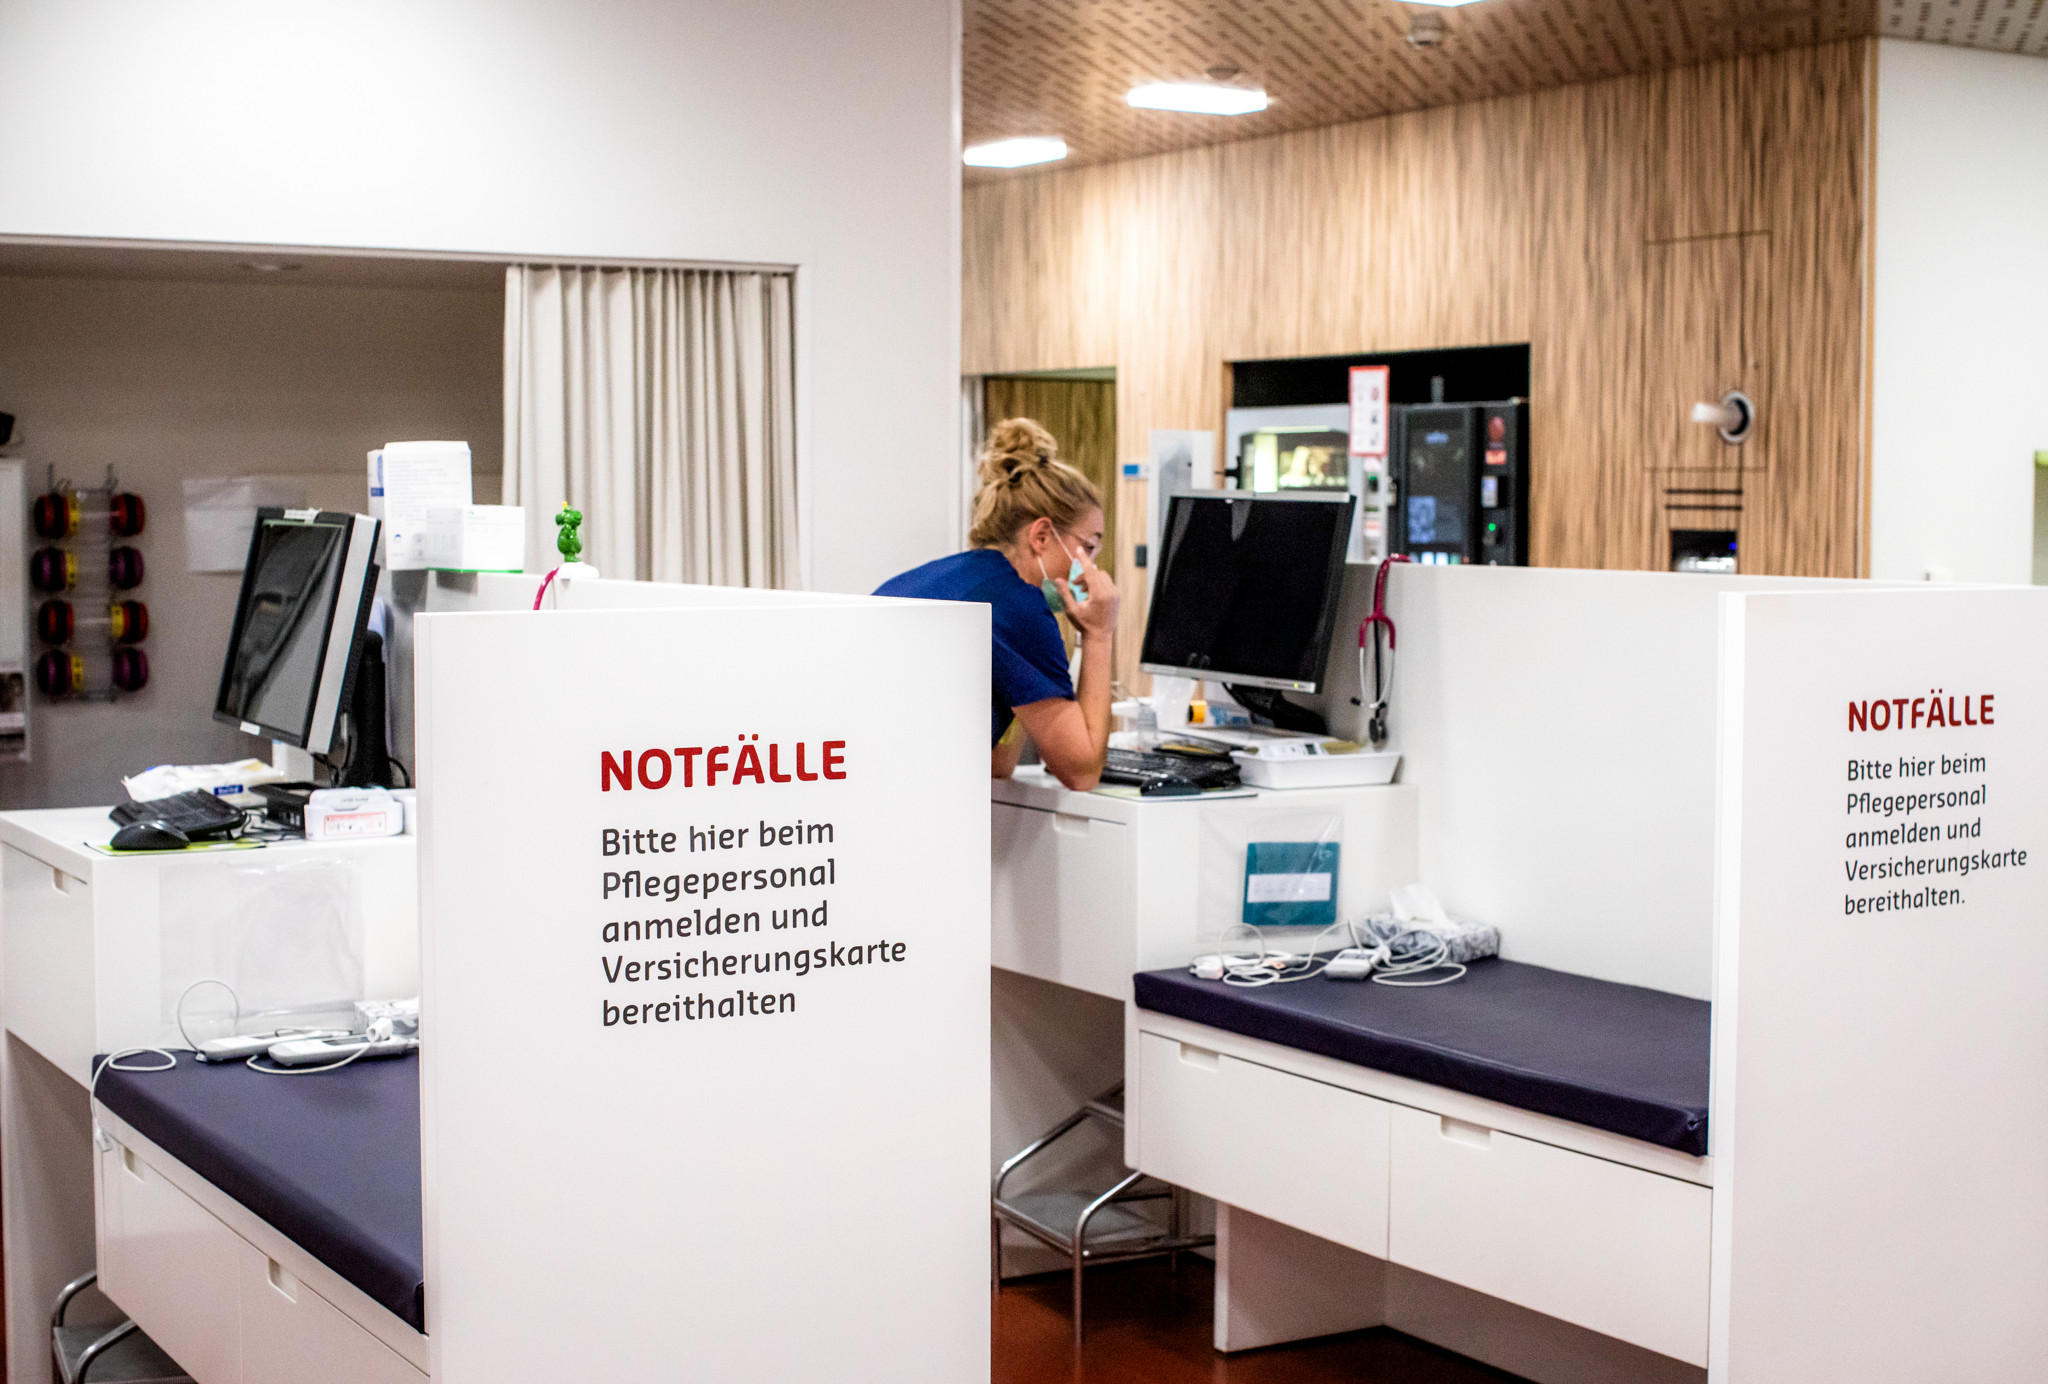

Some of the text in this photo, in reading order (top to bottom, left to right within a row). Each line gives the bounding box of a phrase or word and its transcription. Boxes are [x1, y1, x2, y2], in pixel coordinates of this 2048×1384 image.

[1848, 688, 1995, 732] NOTFÄLLE
[601, 733, 847, 792] NOTFÄLLE
[1847, 752, 1986, 781] Bitte hier beim
[1847, 784, 1987, 817] Pflegepersonal
[602, 819, 834, 856] Bitte hier beim
[1846, 817, 1982, 849] anmelden und
[603, 858, 835, 902] Pflegepersonal
[1845, 848, 2028, 882] Versicherungskarte
[1845, 886, 1965, 916] bereithalten.
[602, 900, 828, 943] anmelden und
[602, 940, 907, 983] Versicherungskarte
[603, 989, 796, 1027] bereithalten
